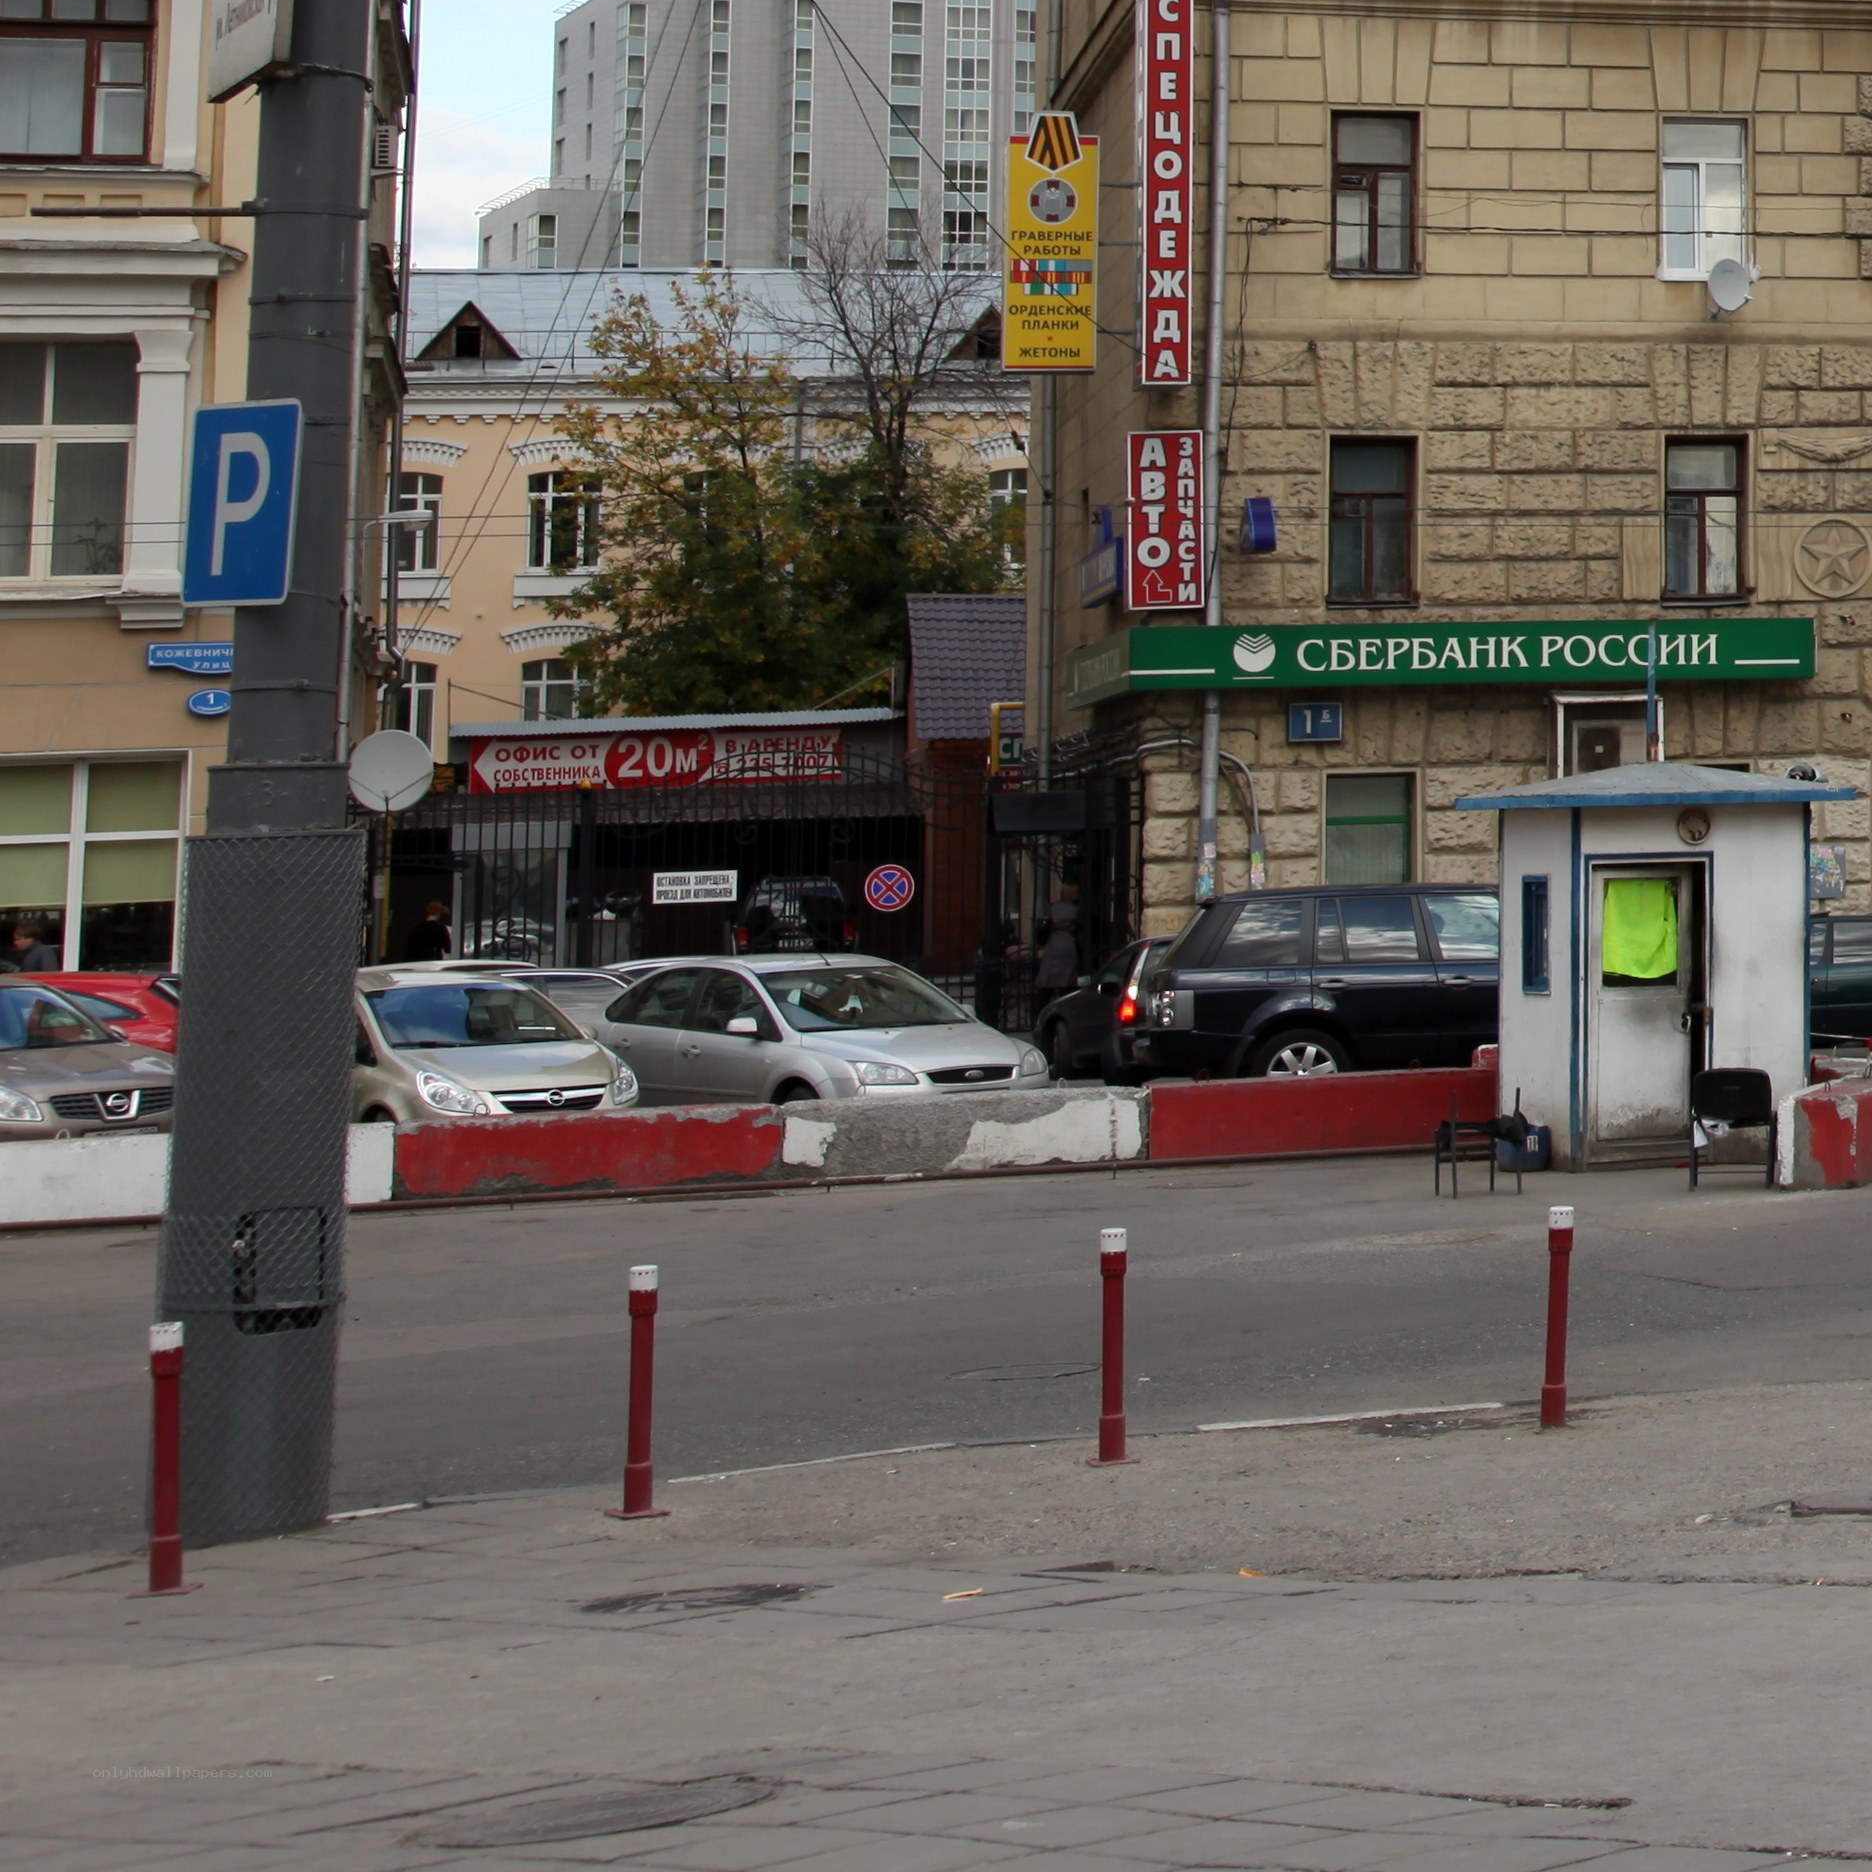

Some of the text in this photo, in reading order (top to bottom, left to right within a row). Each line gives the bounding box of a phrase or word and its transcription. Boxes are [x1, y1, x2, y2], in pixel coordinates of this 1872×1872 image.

[1011, 230, 1093, 242] ГРАВЕРНЫЕ
[1023, 245, 1081, 256] РАБОТЫ
[1008, 305, 1092, 317] ОРДЕНСКИЕ
[1021, 320, 1080, 331] ПЛАНКИ
[1018, 347, 1080, 358] ЖЕТОНЫ
[210, 432, 271, 576] P
[1137, 437, 1171, 568] АВТО
[1176, 436, 1198, 603] ЗАПЧАСТИ
[156, 648, 233, 658] КОЖЕВНИЧ
[1297, 633, 1719, 672] СБЕРБАНК РОССИИ
[206, 693, 215, 705] 1
[1303, 709, 1313, 734] 1
[495, 744, 561, 764] ОФИС
[570, 743, 600, 761] ОТ
[493, 765, 600, 782] СОБСТВЕННИКА
